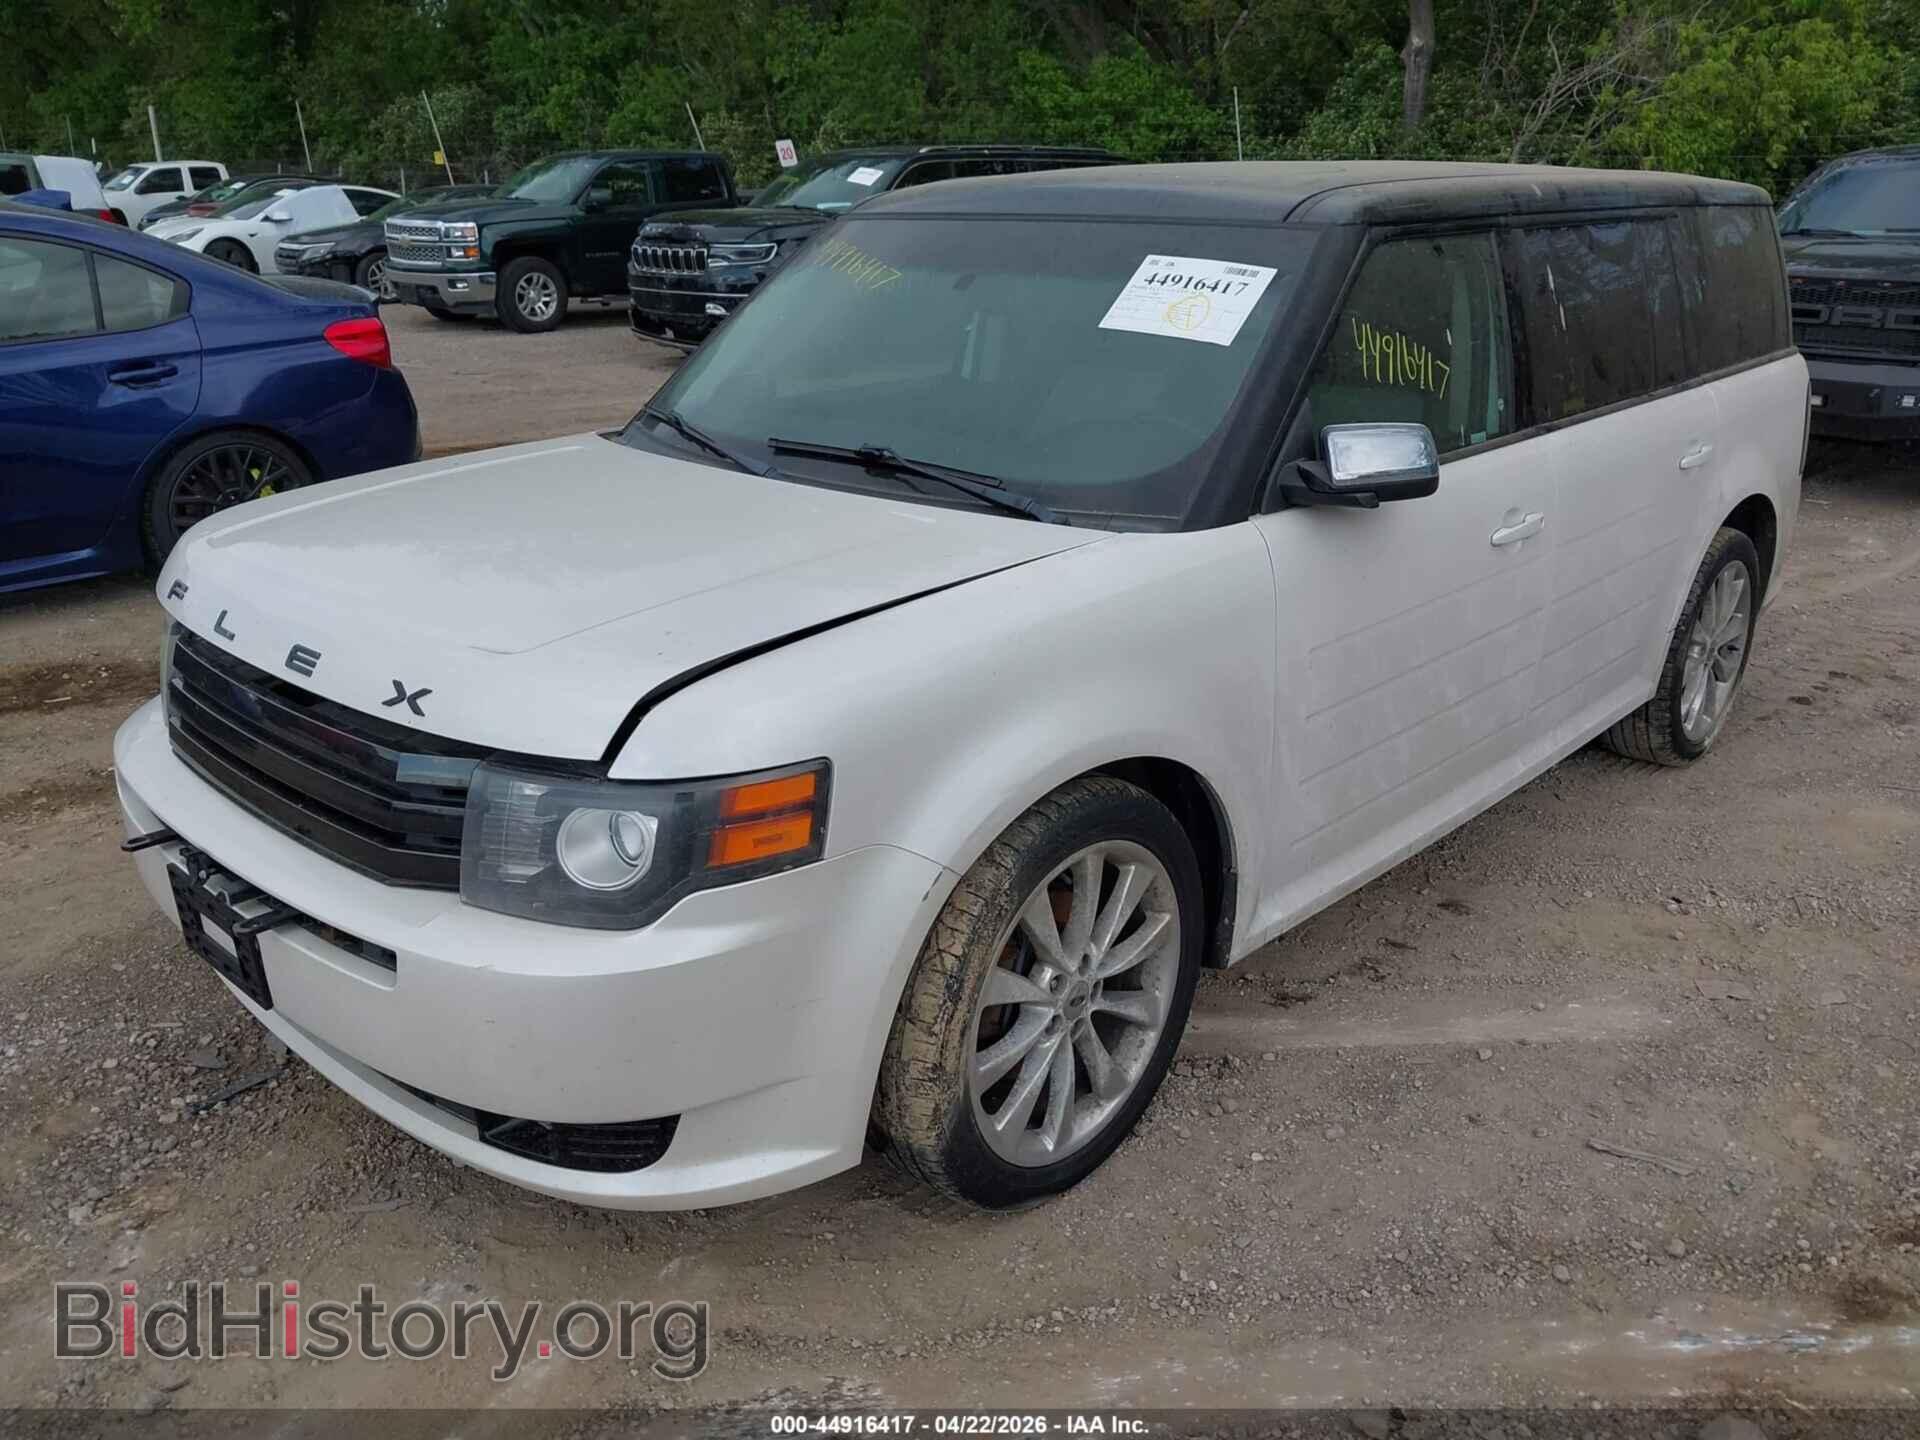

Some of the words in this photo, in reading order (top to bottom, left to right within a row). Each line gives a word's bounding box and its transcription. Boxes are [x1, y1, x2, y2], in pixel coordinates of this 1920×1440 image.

[1143, 271, 1249, 297] 44916417
[1351, 317, 1450, 400] 44916417
[167, 578, 433, 718] FLEX
